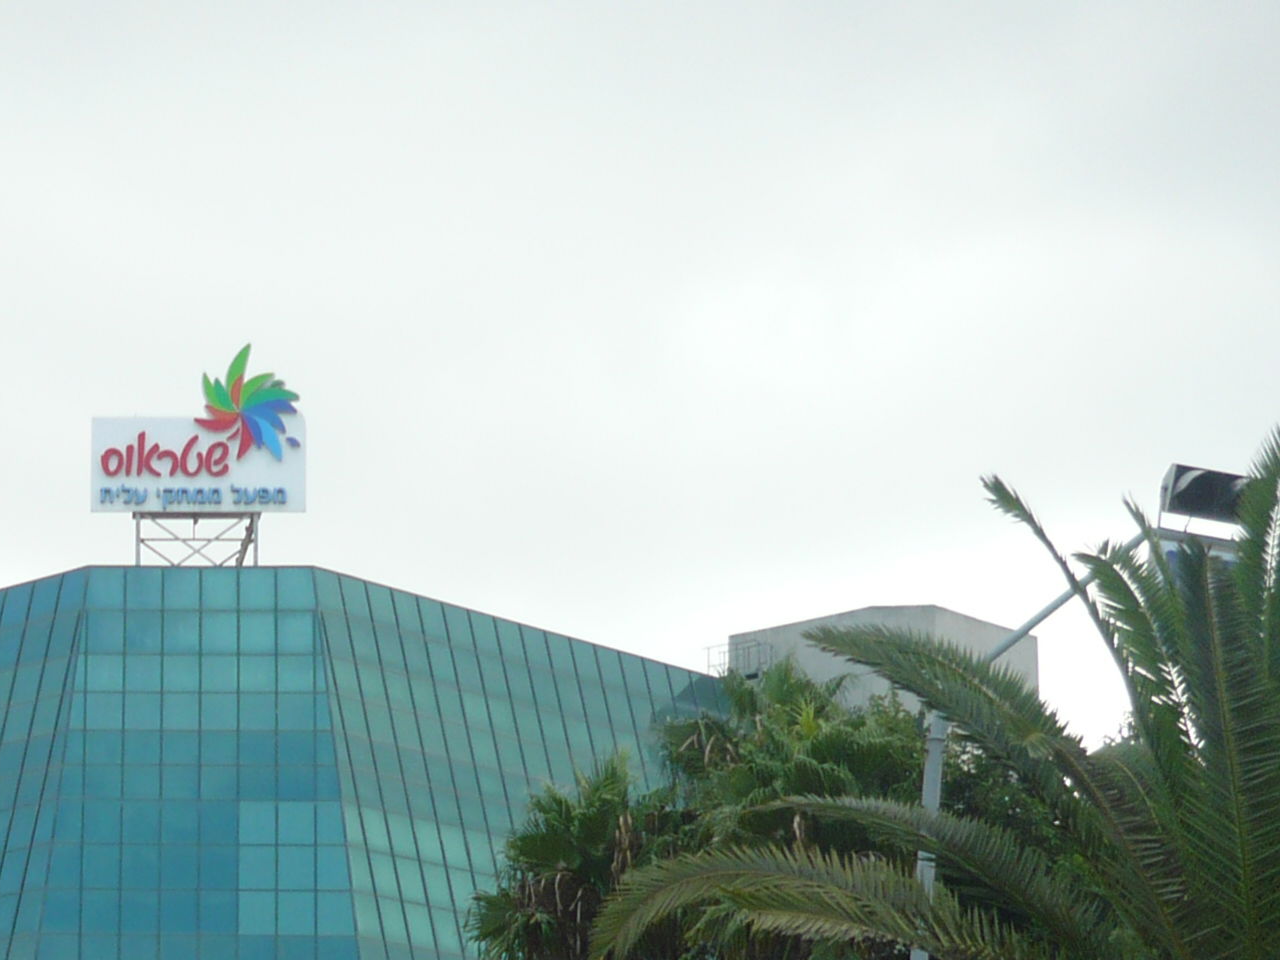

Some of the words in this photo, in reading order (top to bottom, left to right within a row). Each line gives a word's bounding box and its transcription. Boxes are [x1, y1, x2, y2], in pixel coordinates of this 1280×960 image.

[100, 429, 239, 478] שטראוס
[99, 484, 148, 505] עלית
[156, 486, 223, 511] ממתקי
[230, 484, 288, 505] מפעל
